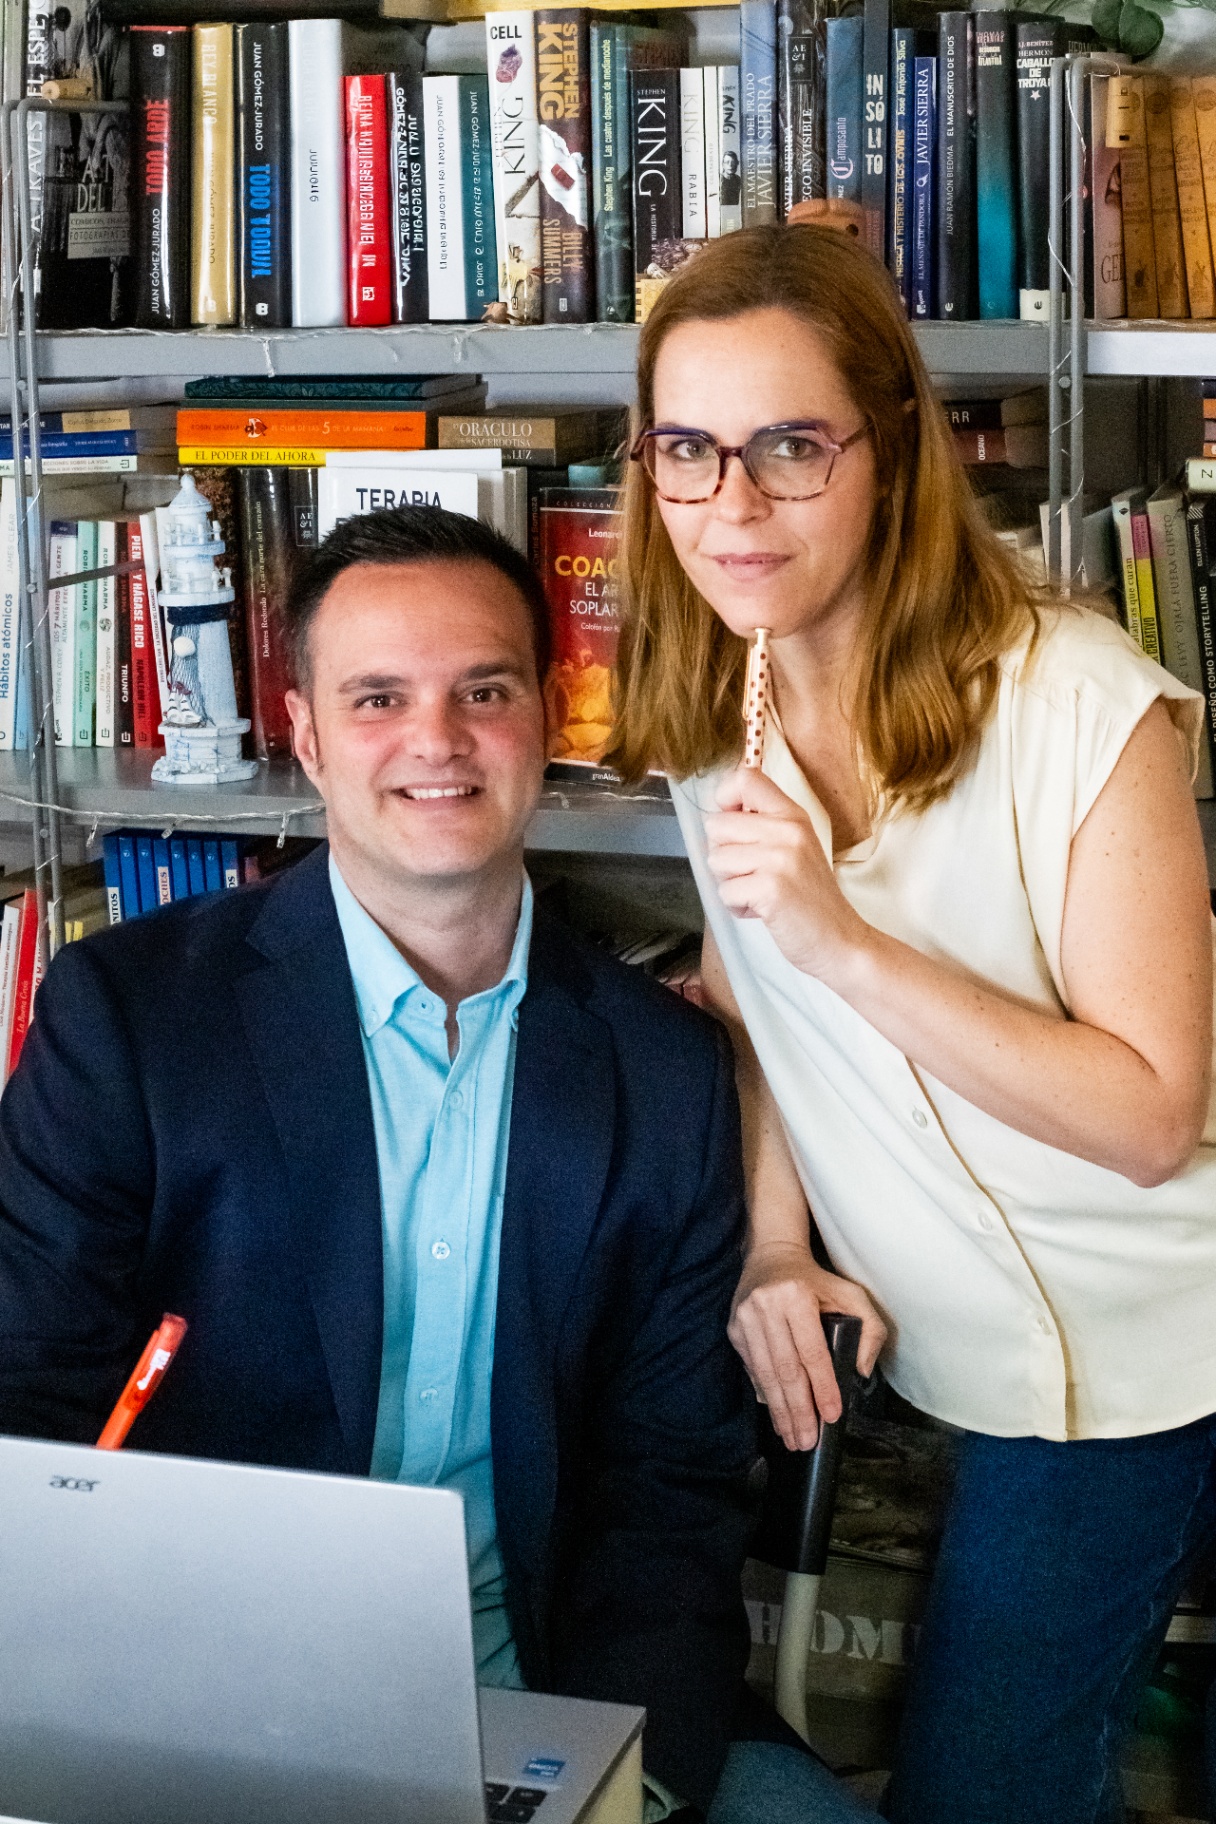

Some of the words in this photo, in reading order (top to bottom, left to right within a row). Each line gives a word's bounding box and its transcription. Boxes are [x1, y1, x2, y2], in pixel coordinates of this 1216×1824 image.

[490, 25, 522, 40] CELL
[946, 35, 955, 56] DIOS
[201, 44, 216, 70] REY
[252, 42, 261, 69] JUAN
[601, 39, 612, 80] medianoche
[896, 39, 906, 60] Silva
[946, 57, 955, 69] DE
[538, 23, 565, 121] KING
[562, 23, 580, 119] STEPHEN
[602, 81, 612, 90] de
[866, 74, 885, 97] IN
[1017, 77, 1047, 88] TROYA
[1028, 67, 1042, 78] DE
[202, 73, 217, 125] BLANCO
[437, 95, 447, 118] JUAN
[470, 91, 481, 114] JUAN
[602, 92, 614, 121] después
[745, 73, 755, 112] PRADO
[757, 74, 773, 140] SIERRA
[897, 96, 907, 115] José
[916, 69, 930, 117] SIERRA
[945, 71, 955, 127] MANUSCRITO
[147, 99, 169, 143] ARDE
[252, 72, 264, 151] GÓMEZ-JURADO
[356, 95, 373, 126] REINA
[683, 94, 700, 153] KING
[722, 95, 738, 134] KING
[865, 97, 885, 122] SÓ
[502, 96, 526, 175] KING
[603, 121, 613, 143] cuatro
[745, 114, 754, 136] DEL
[867, 127, 881, 149] LI
[946, 127, 955, 136] EL
[603, 145, 613, 157] Las
[637, 96, 667, 197] KING
[784, 124, 793, 173] SIERRA
[802, 109, 814, 172] INVISIBLE
[831, 117, 853, 181] Camposanto
[916, 117, 931, 165] JAVIER
[147, 151, 168, 195] TODO
[603, 166, 615, 182] King
[746, 140, 756, 193] MAESTRO
[757, 143, 776, 207] JAVIER
[865, 154, 883, 175] TO
[896, 162, 905, 179] LOS
[945, 144, 954, 177] BIEDMA
[249, 165, 270, 210] TODO
[603, 183, 615, 212] Stephen
[689, 174, 698, 217] RABIA
[896, 180, 905, 193] DE
[944, 180, 955, 211] RAMÓN
[746, 195, 755, 209] EL
[896, 196, 905, 235] MISTERIO
[917, 192, 926, 226] PANDORA
[946, 213, 955, 234] JUAN
[150, 208, 161, 286] GÓMEZ-JURADO
[542, 218, 562, 285] SUMMERS
[563, 231, 583, 270] BILLY
[151, 289, 160, 314] JUAN
[321, 421, 331, 435] 5
[459, 418, 533, 437] ORÁCULO
[195, 450, 205, 461] EL
[210, 450, 248, 461] PODER
[251, 450, 272, 462] DEL
[274, 450, 316, 462] AHORA
[470, 438, 532, 447] SACERDOTISA
[511, 449, 533, 460] LUZ
[355, 487, 442, 510] TERAPIA
[8, 513, 16, 540] CLEAR
[1162, 514, 1176, 556] CIERTO
[6, 541, 15, 574] JAMES
[55, 544, 63, 567] GENTE
[1125, 557, 1135, 586] curan
[1167, 560, 1180, 595] FUERA
[131, 582, 146, 621] HÁGASE
[585, 581, 600, 597] EL
[1129, 587, 1139, 606] que
[0, 593, 13, 648] atómicos
[53, 590, 61, 622] HÁBITOS
[259, 597, 269, 628] Redondo
[1172, 598, 1184, 634] OJALÁ
[133, 624, 145, 648] RICO
[1143, 617, 1158, 654] CREATIVO
[1198, 586, 1214, 657] STORYTELLING
[261, 631, 270, 658] Dolores
[1177, 640, 1188, 667] LEVY
[0, 651, 12, 699] Hábitos
[121, 664, 129, 703] TRIUNFO
[1204, 659, 1216, 689] COMO
[18, 1001, 28, 1022] Buena
[16, 1022, 24, 1034] La
[49, 1474, 101, 1492] acer
